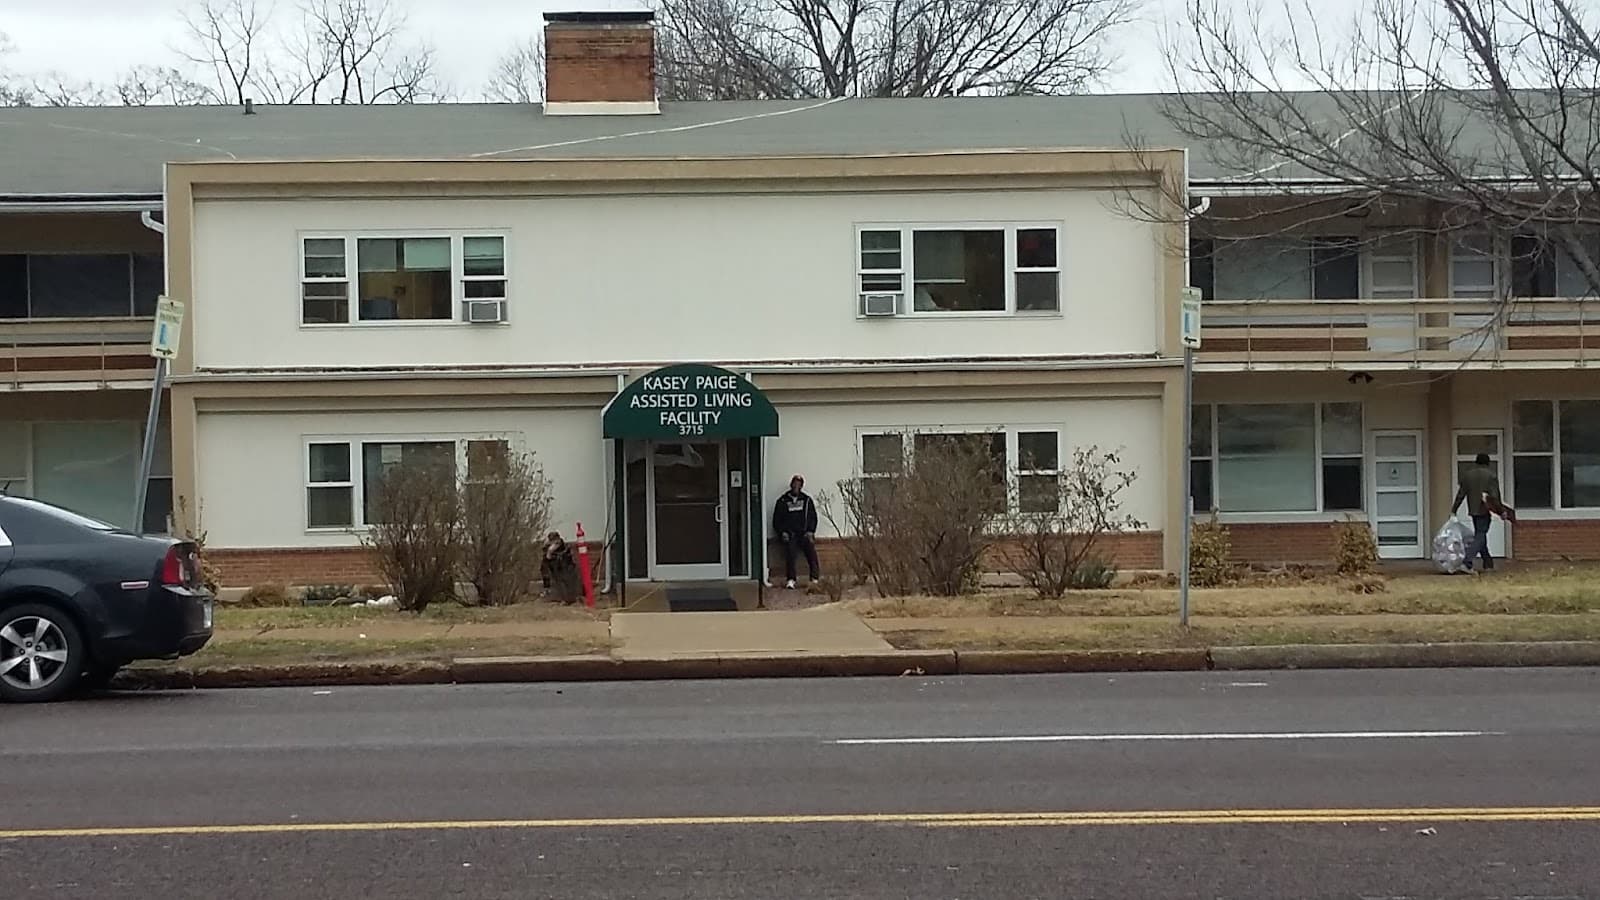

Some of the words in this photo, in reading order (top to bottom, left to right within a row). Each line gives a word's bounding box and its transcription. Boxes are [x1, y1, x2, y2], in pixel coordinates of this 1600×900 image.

[643, 376, 689, 390] KASEY
[696, 376, 737, 389] PAIGE
[630, 394, 698, 408] ASSISTED
[704, 393, 752, 407] LIVING
[660, 411, 721, 425] FACILITY
[679, 425, 704, 435] 3715
